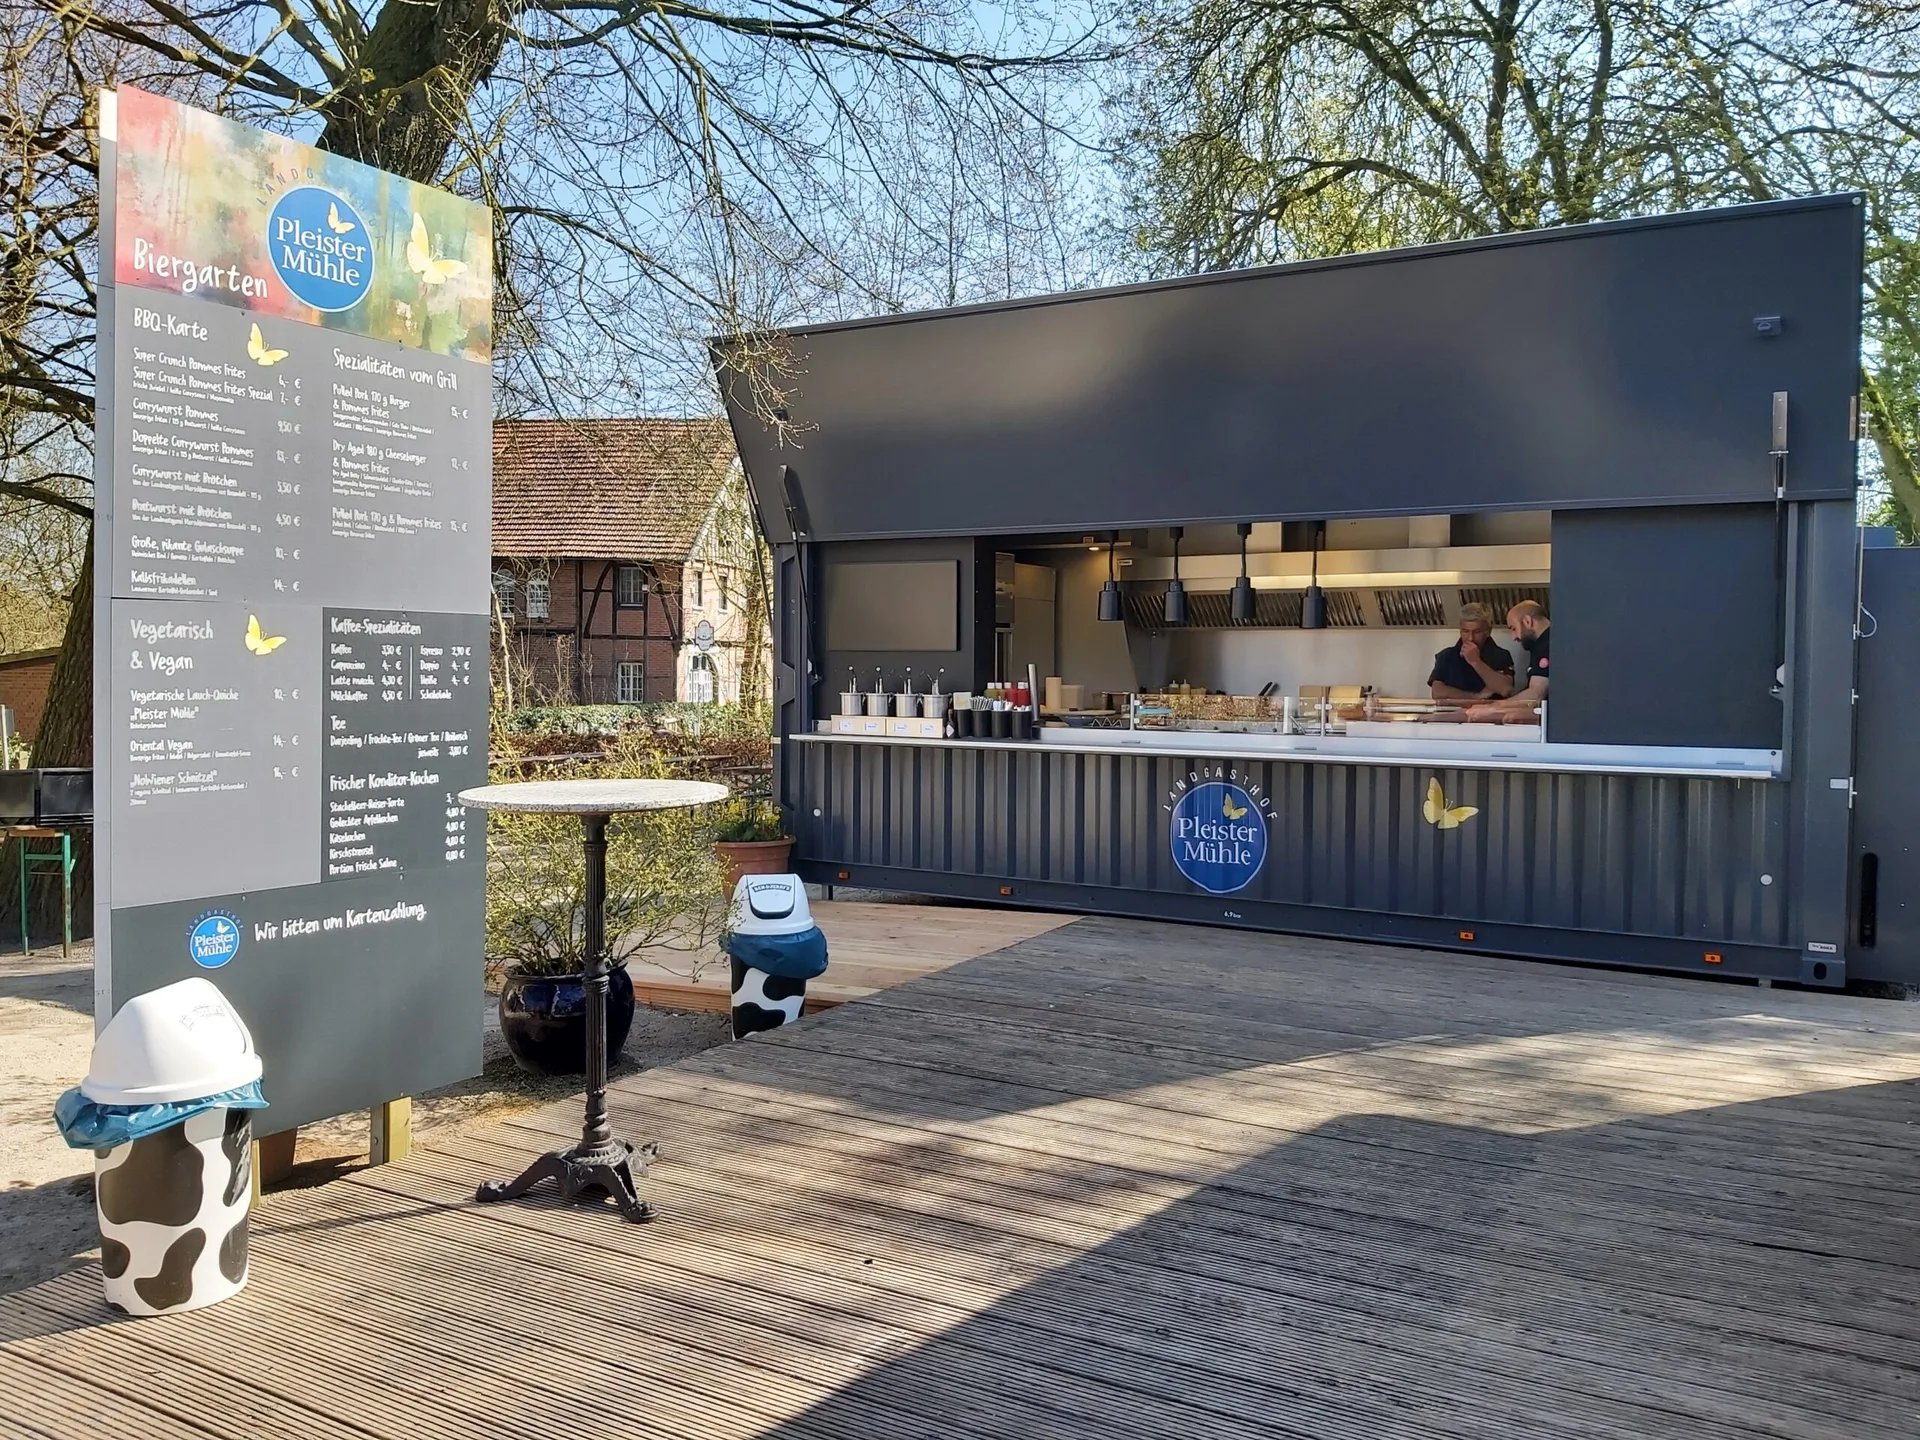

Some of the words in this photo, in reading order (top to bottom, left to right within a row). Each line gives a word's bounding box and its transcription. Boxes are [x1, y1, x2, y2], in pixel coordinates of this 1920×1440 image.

[276, 216, 367, 264] Pleister
[134, 238, 268, 298] Biergarten
[281, 244, 360, 287] Mühle
[134, 308, 208, 341] BBQ-Karte
[134, 348, 156, 362] Super
[158, 352, 186, 369] Crunch
[188, 356, 222, 375] Pommes
[224, 364, 246, 379] Frites
[294, 378, 301, 389] €
[333, 348, 405, 379] Spezialitäten
[409, 370, 434, 385] vom
[437, 370, 458, 391] Grill
[133, 366, 156, 381] Super
[158, 371, 186, 387] Crunch
[188, 376, 222, 394] Pommes
[224, 382, 246, 397] Frites
[248, 386, 274, 402] Spezial
[294, 396, 301, 406] €
[333, 384, 352, 398] Pulled
[354, 387, 368, 400] Pork
[390, 394, 411, 410] Burger
[133, 398, 183, 416] Currywurst
[186, 404, 218, 422] Pommes
[294, 424, 301, 434] €
[333, 399, 340, 410] &
[342, 400, 369, 415] Pommes
[371, 405, 390, 419] Frites
[462, 409, 468, 419] €
[132, 429, 168, 447] Doppelte
[171, 435, 220, 453] Currywurst
[221, 441, 254, 458] Pommes
[294, 453, 301, 464] €
[332, 439, 345, 453] Dry
[348, 442, 364, 456] Aged
[385, 448, 427, 466] Cheeseburger
[333, 457, 340, 467] &
[342, 457, 369, 472] Pommes
[371, 462, 390, 475] Frites
[462, 460, 468, 470] €
[132, 464, 182, 482] Currywurst
[184, 470, 201, 483] mit
[202, 471, 238, 488] Brötchen
[294, 484, 301, 495] €
[132, 499, 177, 515] Bratwurst
[179, 504, 195, 517] mit
[197, 504, 232, 520] Brötchen
[294, 516, 300, 527] €
[332, 507, 352, 520] Pulled
[354, 509, 368, 522] Pork
[396, 514, 422, 528] Pommes
[424, 517, 442, 530] Frites
[462, 522, 468, 532] €
[132, 535, 159, 551] Große,
[162, 539, 192, 552] pikante
[293, 550, 300, 560] €
[131, 570, 196, 586] Kalbsfrikadellen
[293, 581, 300, 592] €
[130, 619, 214, 644] Vegetarisch
[331, 617, 422, 636] Kaffee-Spezialitäten
[331, 643, 352, 655] Kaffee
[396, 646, 402, 655] €
[466, 646, 472, 656] €
[130, 650, 143, 669] &
[149, 651, 193, 676] Vegan
[396, 660, 402, 670] €
[464, 661, 470, 670] €
[331, 675, 351, 685] Latte
[397, 676, 404, 686] €
[463, 676, 470, 685] €
[130, 689, 185, 704] Vegetarische
[187, 688, 239, 701] Lauch-Quiche
[292, 689, 299, 700] €
[330, 690, 368, 702] Milchkaffee
[397, 691, 403, 701] €
[331, 715, 346, 731] Tee
[130, 740, 164, 752] Oriental
[168, 739, 193, 754] Vegan
[292, 735, 299, 746] €
[462, 746, 468, 755] €
[292, 766, 299, 777] €
[330, 774, 366, 792] Frischer
[368, 770, 439, 789] Konditor-Kuchen
[1163, 767, 1278, 819] LANDGASTHOF
[460, 806, 466, 816] €
[460, 821, 466, 830] €
[1178, 816, 1258, 842] Pleister
[460, 834, 465, 844] €
[329, 863, 354, 875] Portion
[459, 850, 465, 859] €
[1183, 841, 1250, 865] Mühle
[255, 922, 279, 942] Wir
[282, 918, 319, 938] bitten
[323, 917, 343, 931] um
[346, 901, 427, 928] Kartenzahlung
[195, 933, 235, 947] Pleister
[197, 943, 232, 957] Mühle
